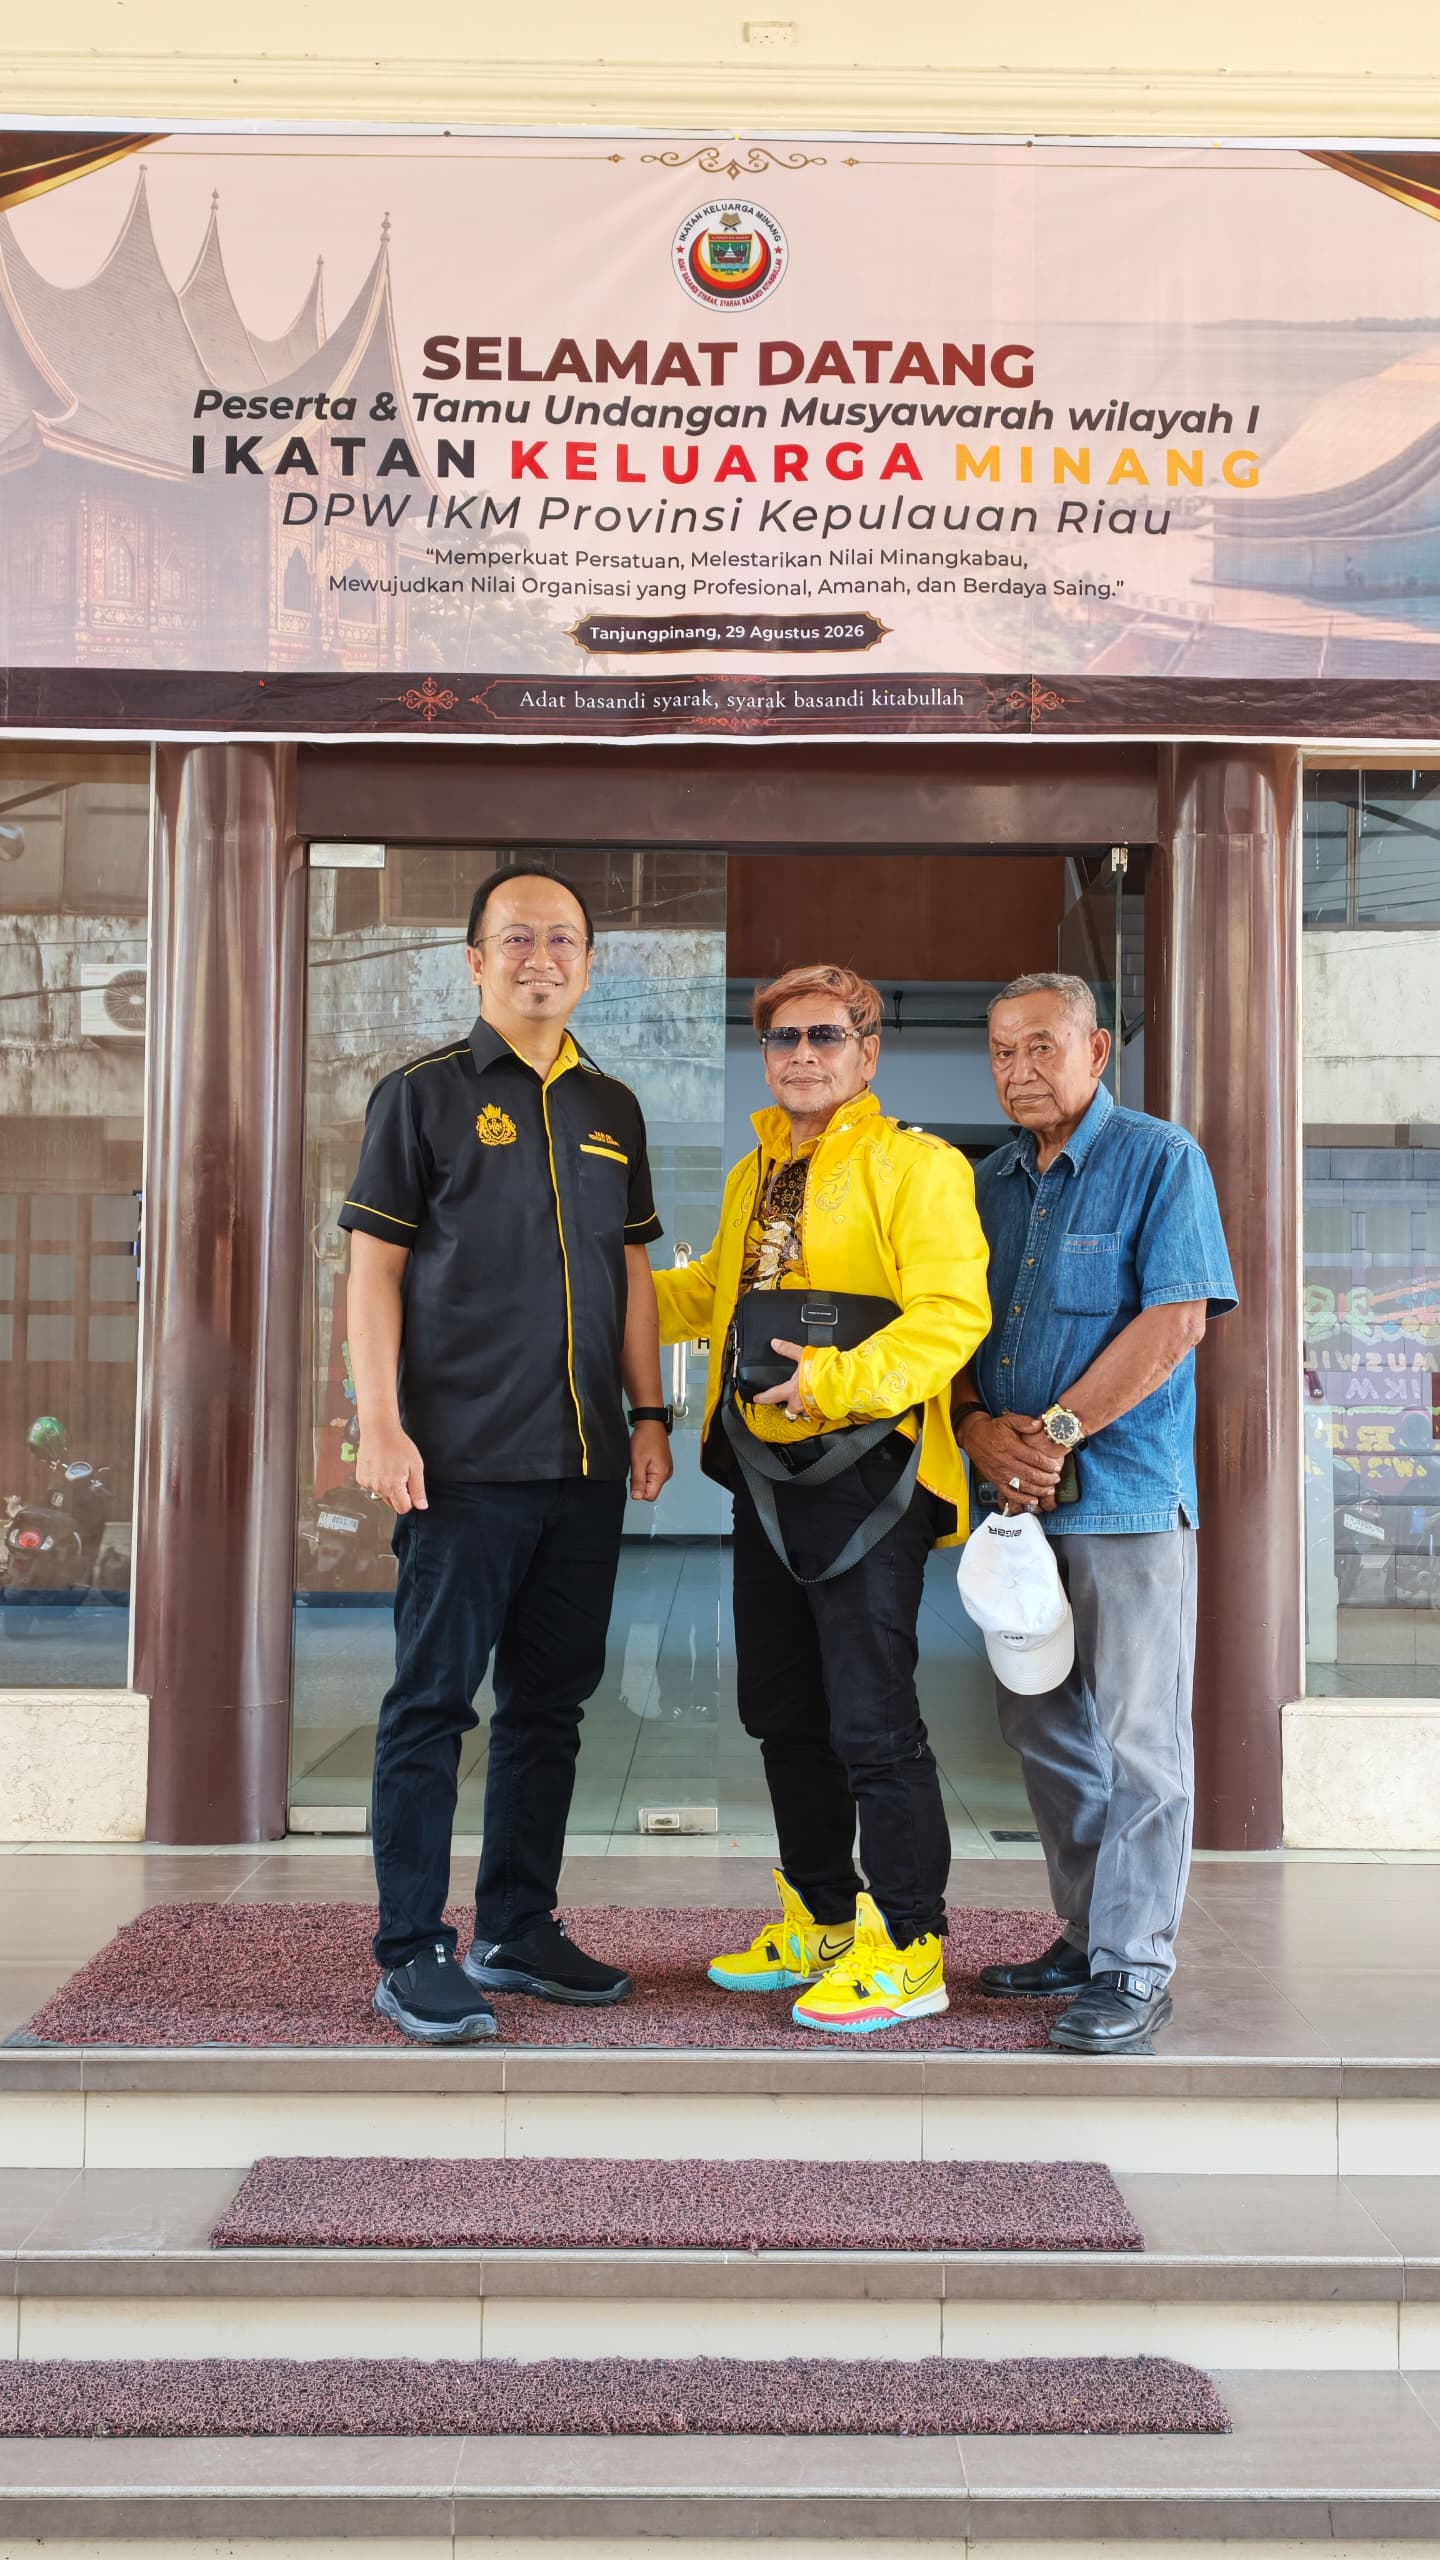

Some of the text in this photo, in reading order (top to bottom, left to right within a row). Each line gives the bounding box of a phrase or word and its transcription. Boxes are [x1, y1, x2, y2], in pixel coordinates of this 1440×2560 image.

[679, 203, 782, 242] IKATAN KELUARGA MINANG
[422, 335, 1035, 389] SELAMAT DATANG
[193, 389, 1260, 440] Peserta & Tamu Undangan Musyawarah wilayah I
[192, 435, 1260, 489] IKATAN KELUARGA MINANG
[282, 492, 412, 528] DPW
[426, 494, 521, 530] IKM
[539, 496, 743, 534] Provinsi
[758, 495, 1037, 540] Kepulauan
[1057, 499, 1171, 535] Riau
[576, 550, 685, 571] Persatuan,
[691, 550, 822, 568] Melestarikan
[829, 548, 873, 566] Nilai
[880, 548, 1028, 570] Minangkabau,
[329, 575, 1047, 601] Mewujudkan Nilai Organisasi yang Profesional, Amanah, dan Berdaya
[589, 625, 721, 643] Tanjungpinang,
[725, 625, 746, 638] 29
[749, 625, 820, 642] Agustus
[519, 624, 865, 712] 2026 Adat basandi syarak, syarak basandi
